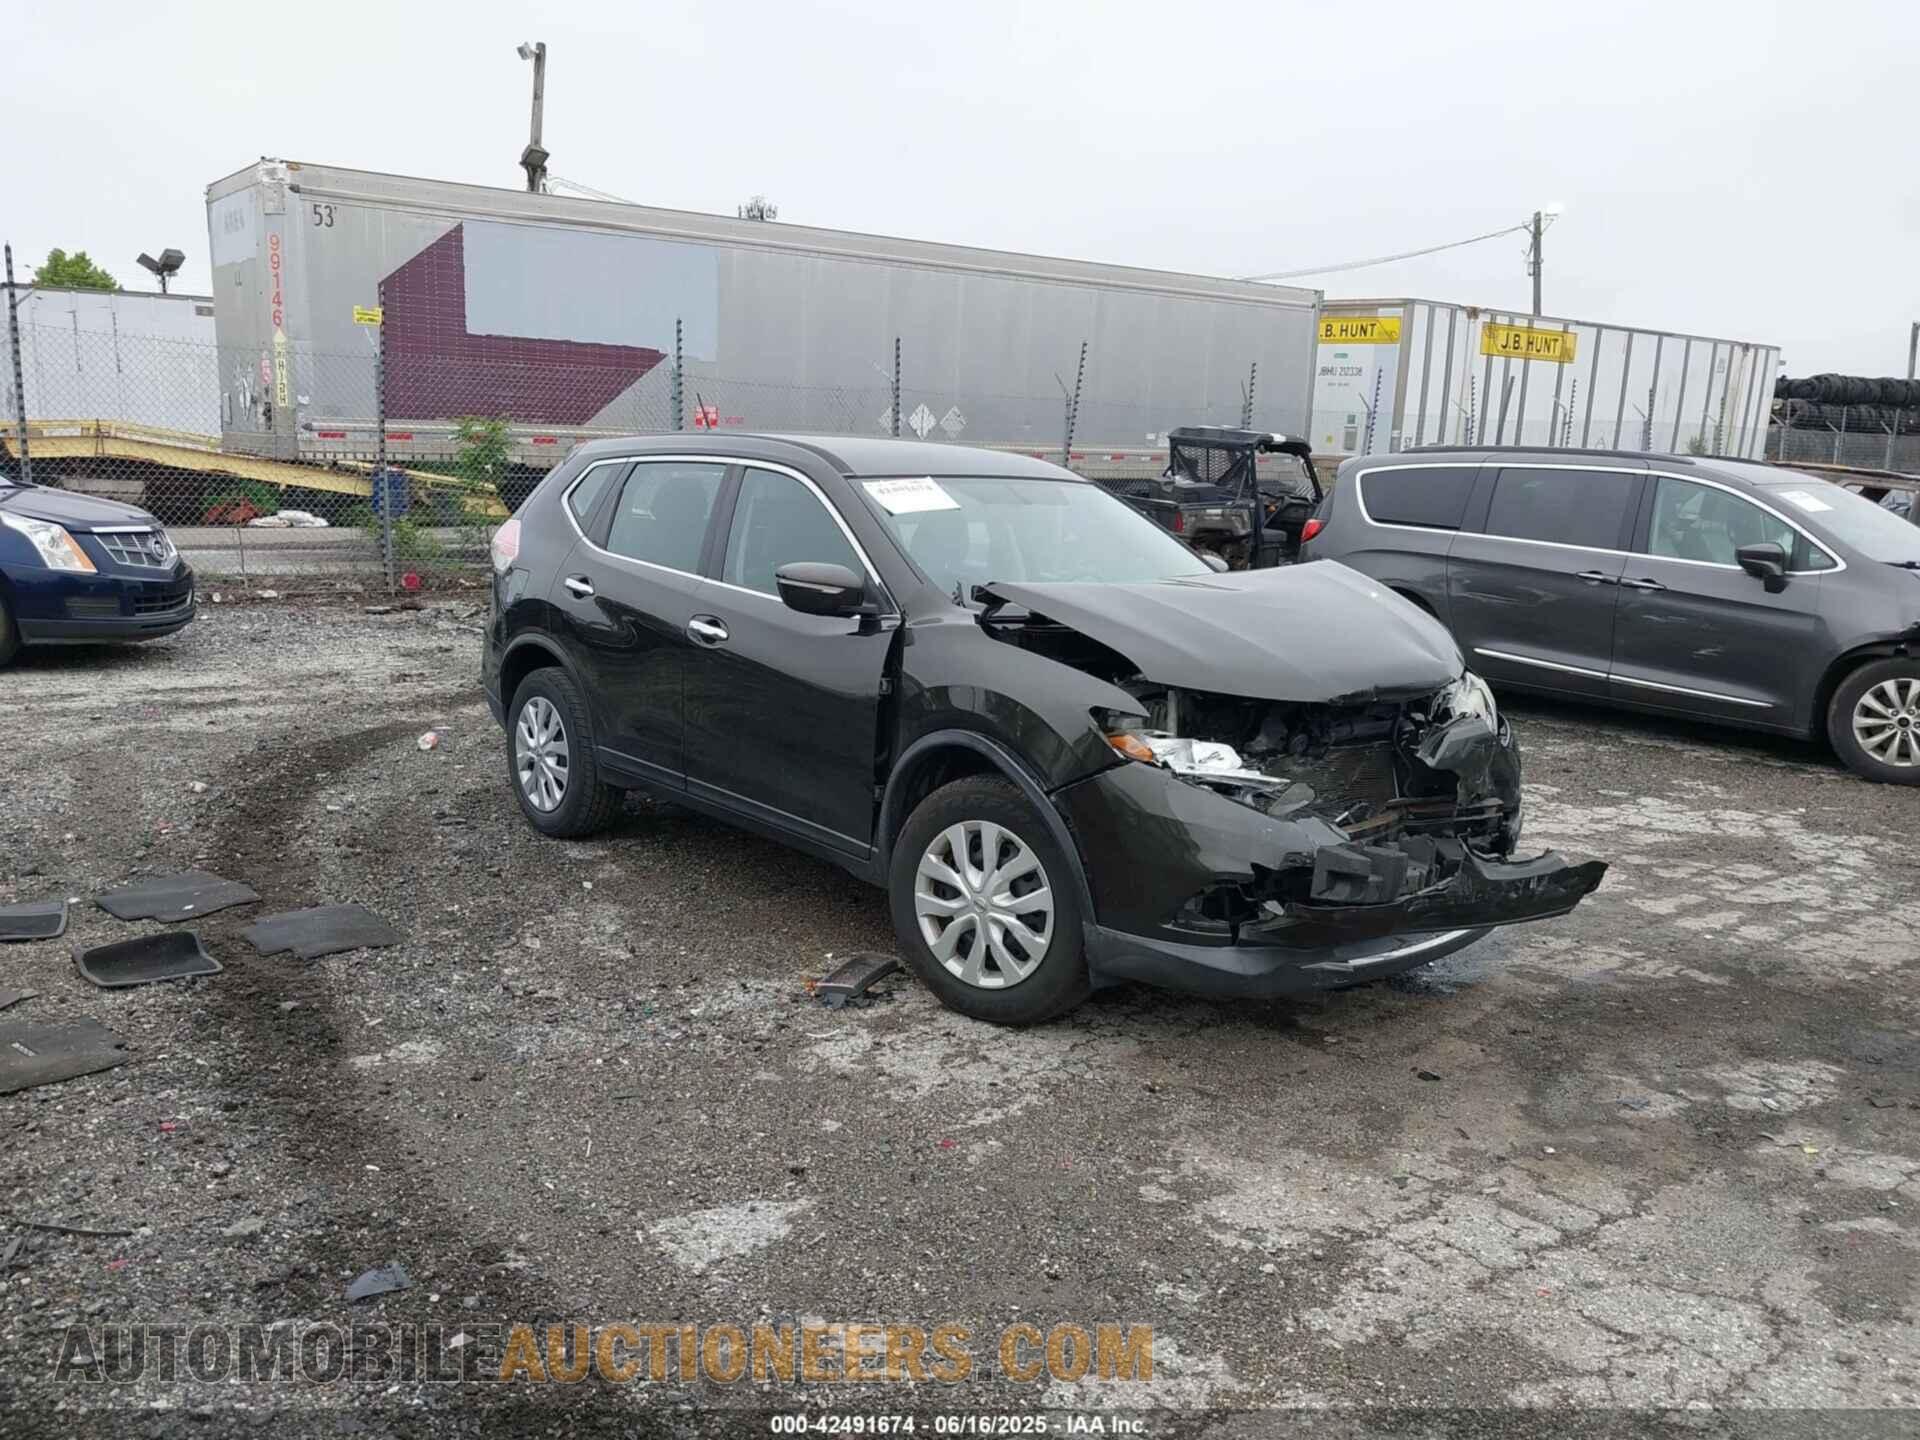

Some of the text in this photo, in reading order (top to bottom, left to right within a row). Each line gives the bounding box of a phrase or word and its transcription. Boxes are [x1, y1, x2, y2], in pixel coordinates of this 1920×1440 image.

[313, 203, 337, 228] 53'
[270, 233, 282, 327] 99146
[1319, 323, 1376, 338] .B. HUNT
[1501, 332, 1560, 355] J.B. HUNT
